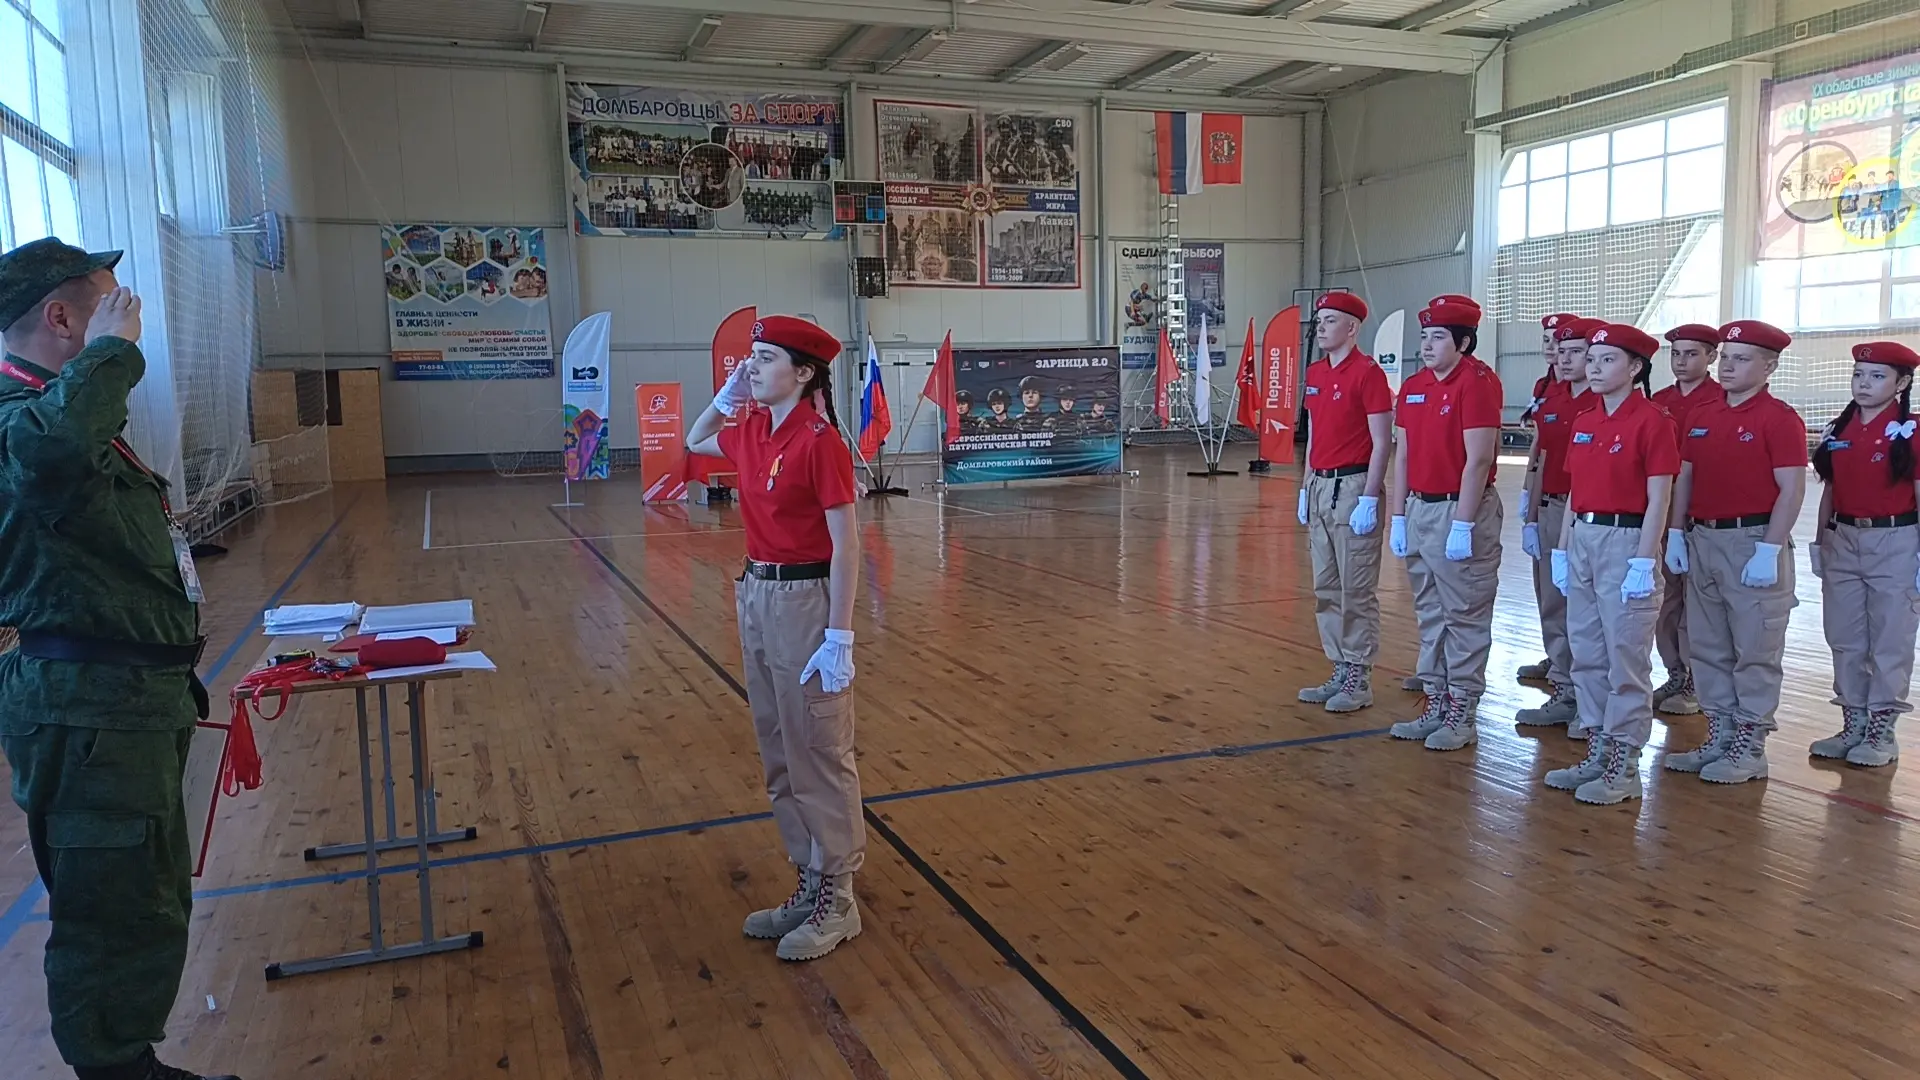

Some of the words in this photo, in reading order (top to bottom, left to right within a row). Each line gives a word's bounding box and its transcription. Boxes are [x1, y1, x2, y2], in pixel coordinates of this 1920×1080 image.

[1826, 71, 1884, 95] областные
[581, 97, 720, 120] ДОМБАРОВЦЫ
[729, 103, 760, 124] ЗА
[764, 103, 841, 124] СПОРТ!
[1055, 118, 1072, 128] СВО
[886, 184, 930, 195] ОССИЙСКИЙ
[888, 196, 917, 205] СОЛДАТ
[1035, 193, 1076, 201] ХРАНИТЕЛЬ
[1040, 216, 1074, 226] Кавказ
[1182, 248, 1222, 259] ВЫБОР
[407, 319, 445, 327] ЖИЗНИ
[1035, 358, 1089, 369] ЗАРНИЦА
[1091, 357, 1109, 367] 2.0
[1266, 347, 1283, 410] Первые
